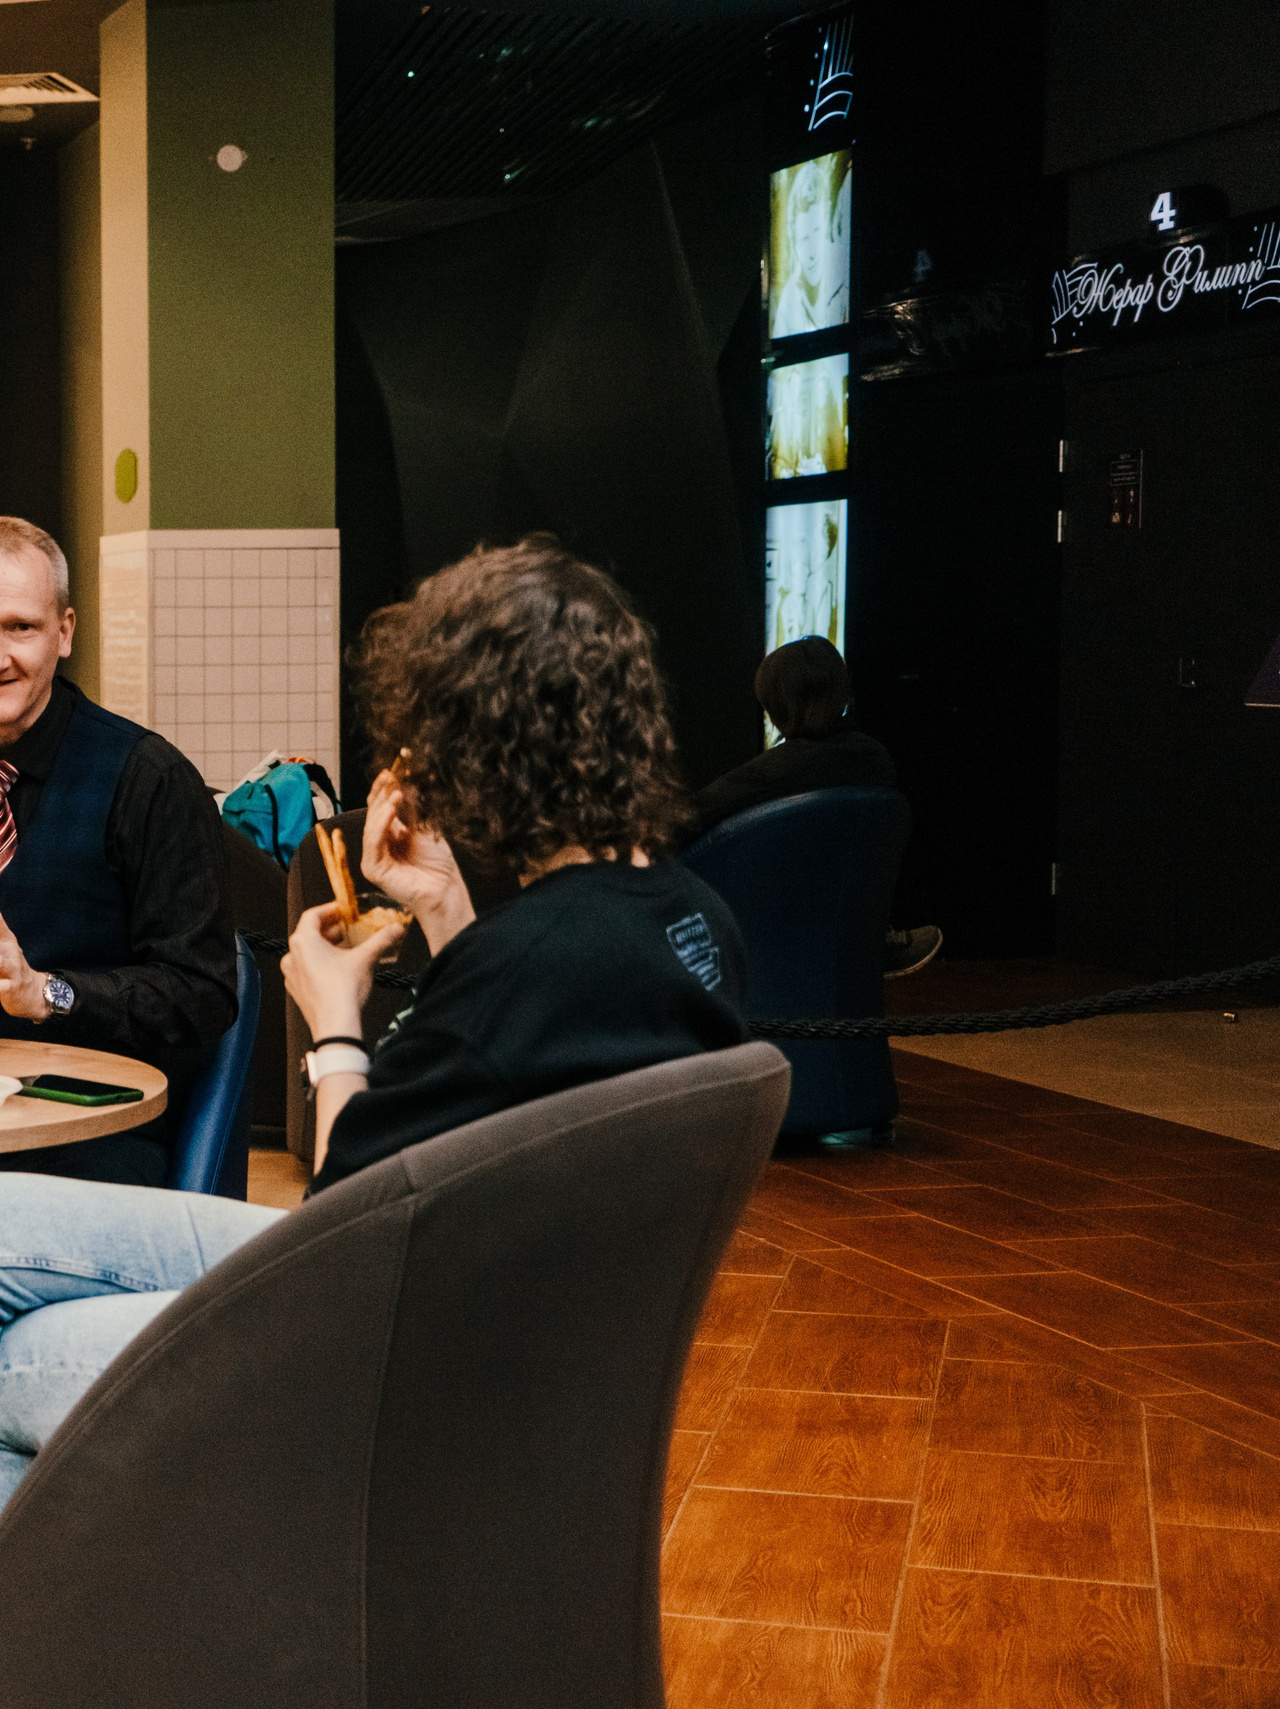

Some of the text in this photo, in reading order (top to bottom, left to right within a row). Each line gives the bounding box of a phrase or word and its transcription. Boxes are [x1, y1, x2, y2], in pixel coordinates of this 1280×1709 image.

[1150, 191, 1177, 232] 4
[1072, 244, 1265, 327] Жерар Филипп
